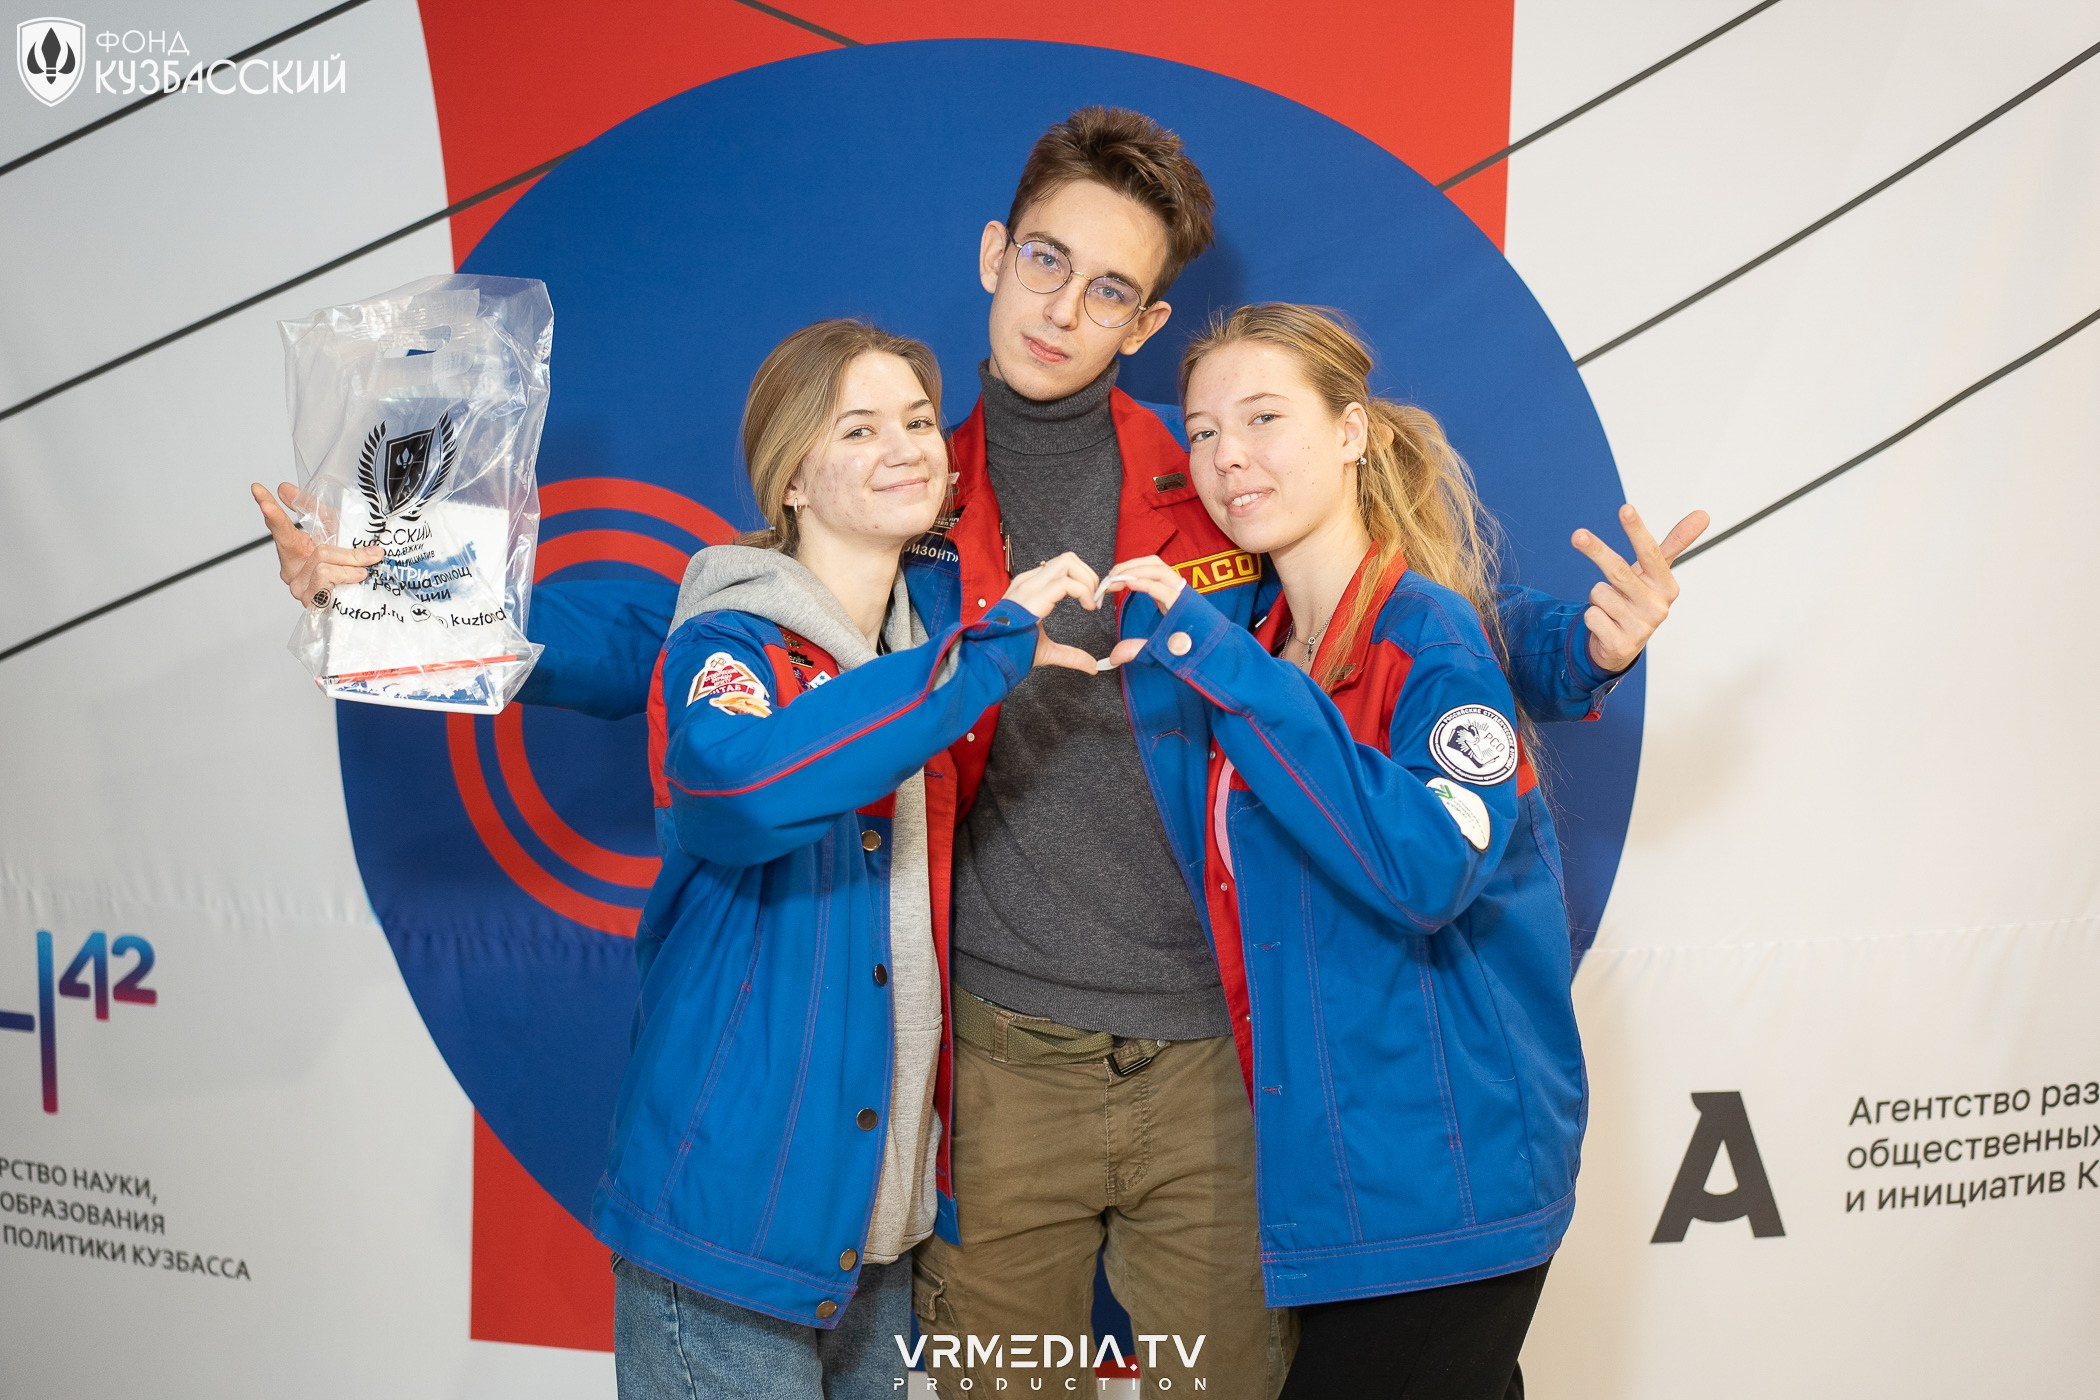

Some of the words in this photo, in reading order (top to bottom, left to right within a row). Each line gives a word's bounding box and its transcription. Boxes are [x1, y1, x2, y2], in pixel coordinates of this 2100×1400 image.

[451, 606, 507, 627] kuzfond
[1483, 732, 1506, 752] РСО
[1848, 1087, 2031, 1127] Агентство
[2041, 1081, 2100, 1116] раз
[1847, 1124, 2100, 1170] общественных
[0, 1157, 68, 1187] РСТВО
[72, 1166, 158, 1206] НАУКИ,
[1844, 1190, 1866, 1214] и
[1877, 1170, 2067, 1210] инициатив
[0, 1190, 165, 1236] ОБРАЗОВАНИЯ
[3, 1224, 128, 1264] ПОЛИТИКИ
[131, 1244, 253, 1282] КУЗБАССА
